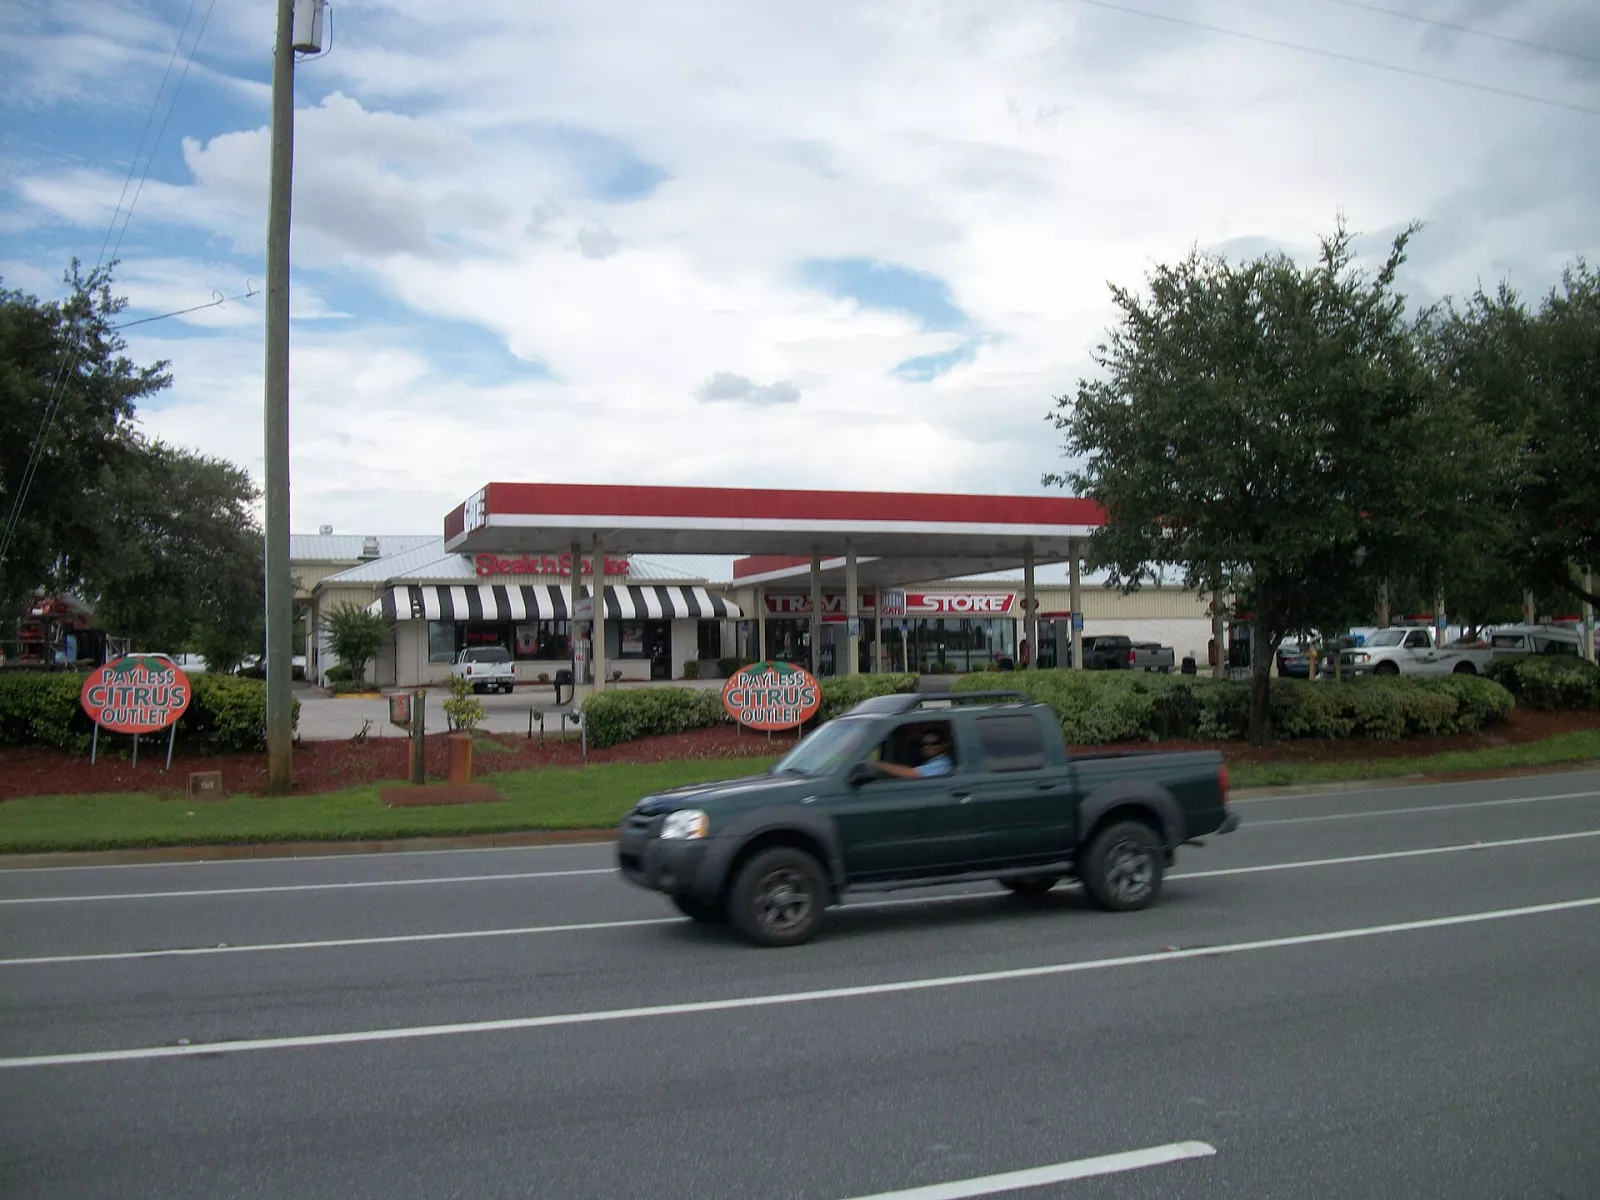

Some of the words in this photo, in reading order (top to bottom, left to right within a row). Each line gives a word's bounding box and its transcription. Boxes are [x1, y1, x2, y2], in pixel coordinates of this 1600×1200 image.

[922, 594, 1008, 612] STORE
[102, 668, 176, 685] PAYLESS
[738, 670, 805, 688] PAYLESS
[87, 685, 186, 708] CITRUS
[727, 688, 816, 708] CITRUS
[101, 707, 169, 725] OUTLET
[741, 706, 802, 725] OUTLET
